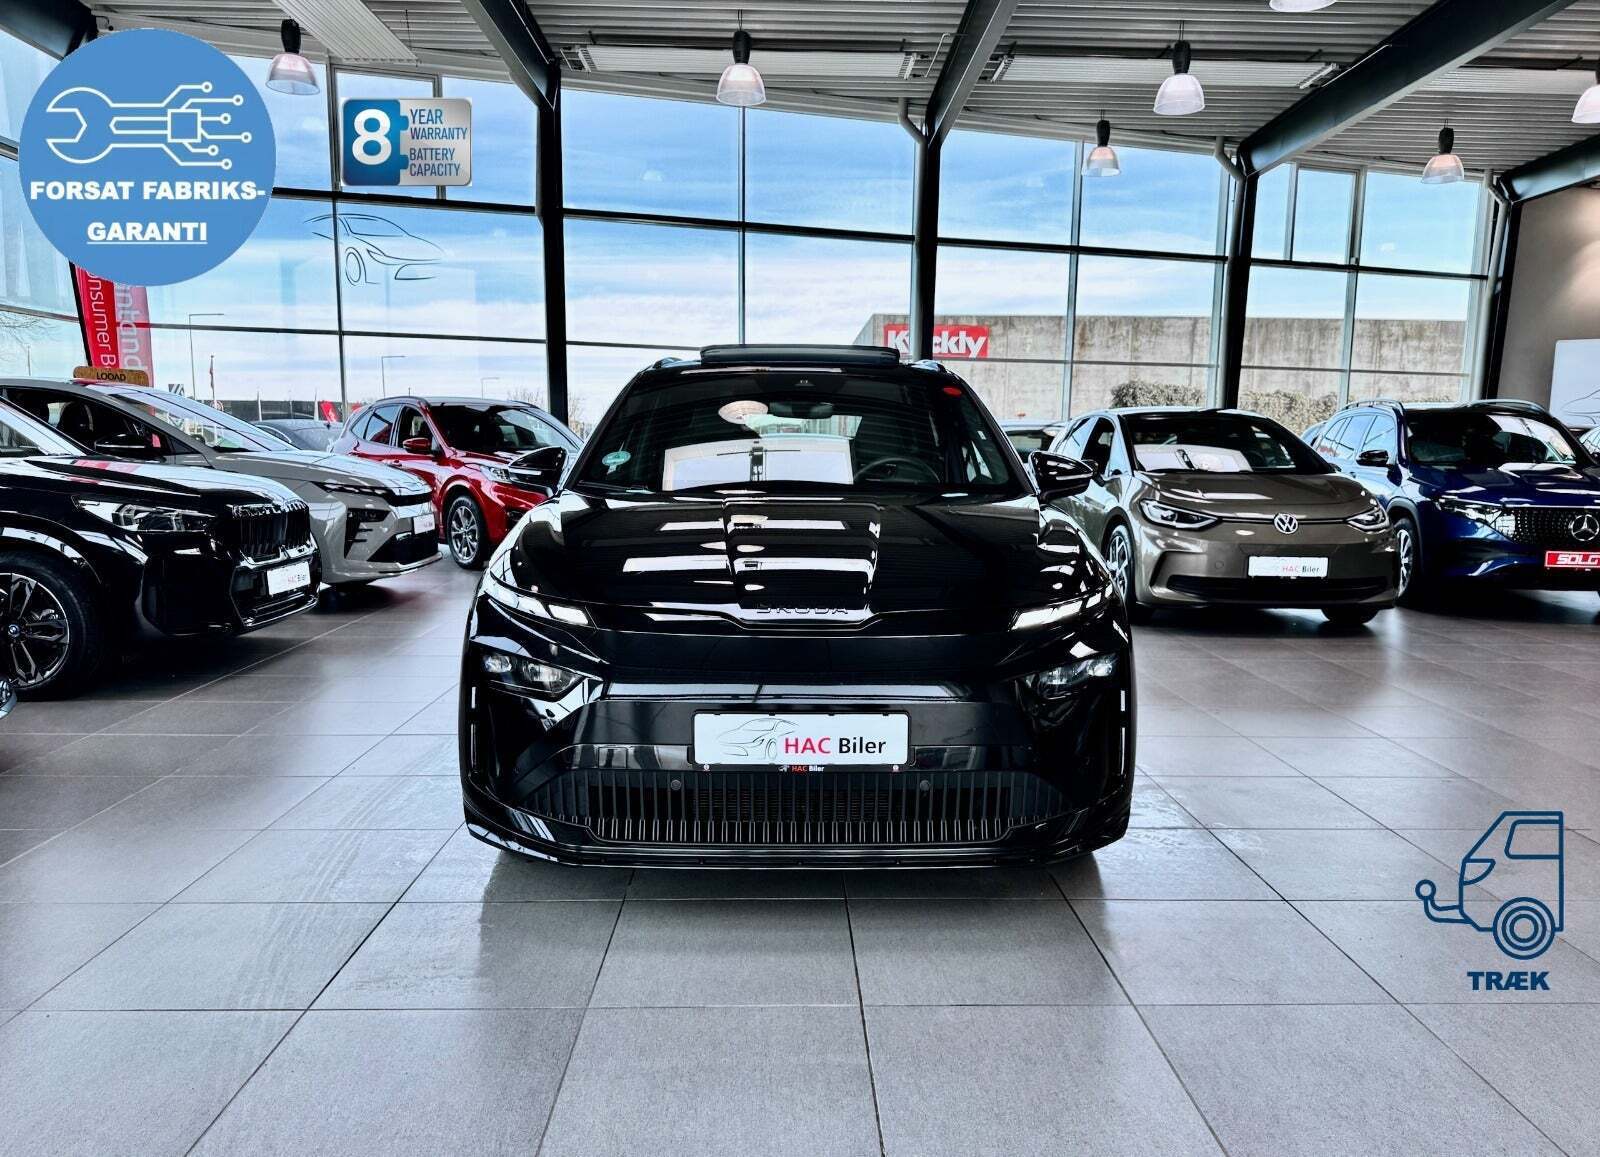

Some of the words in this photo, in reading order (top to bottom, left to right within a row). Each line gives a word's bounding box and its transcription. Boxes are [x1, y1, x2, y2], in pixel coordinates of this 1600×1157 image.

[87, 272, 112, 351] nsumer
[784, 737, 831, 754] HAC
[838, 736, 887, 754] Biler
